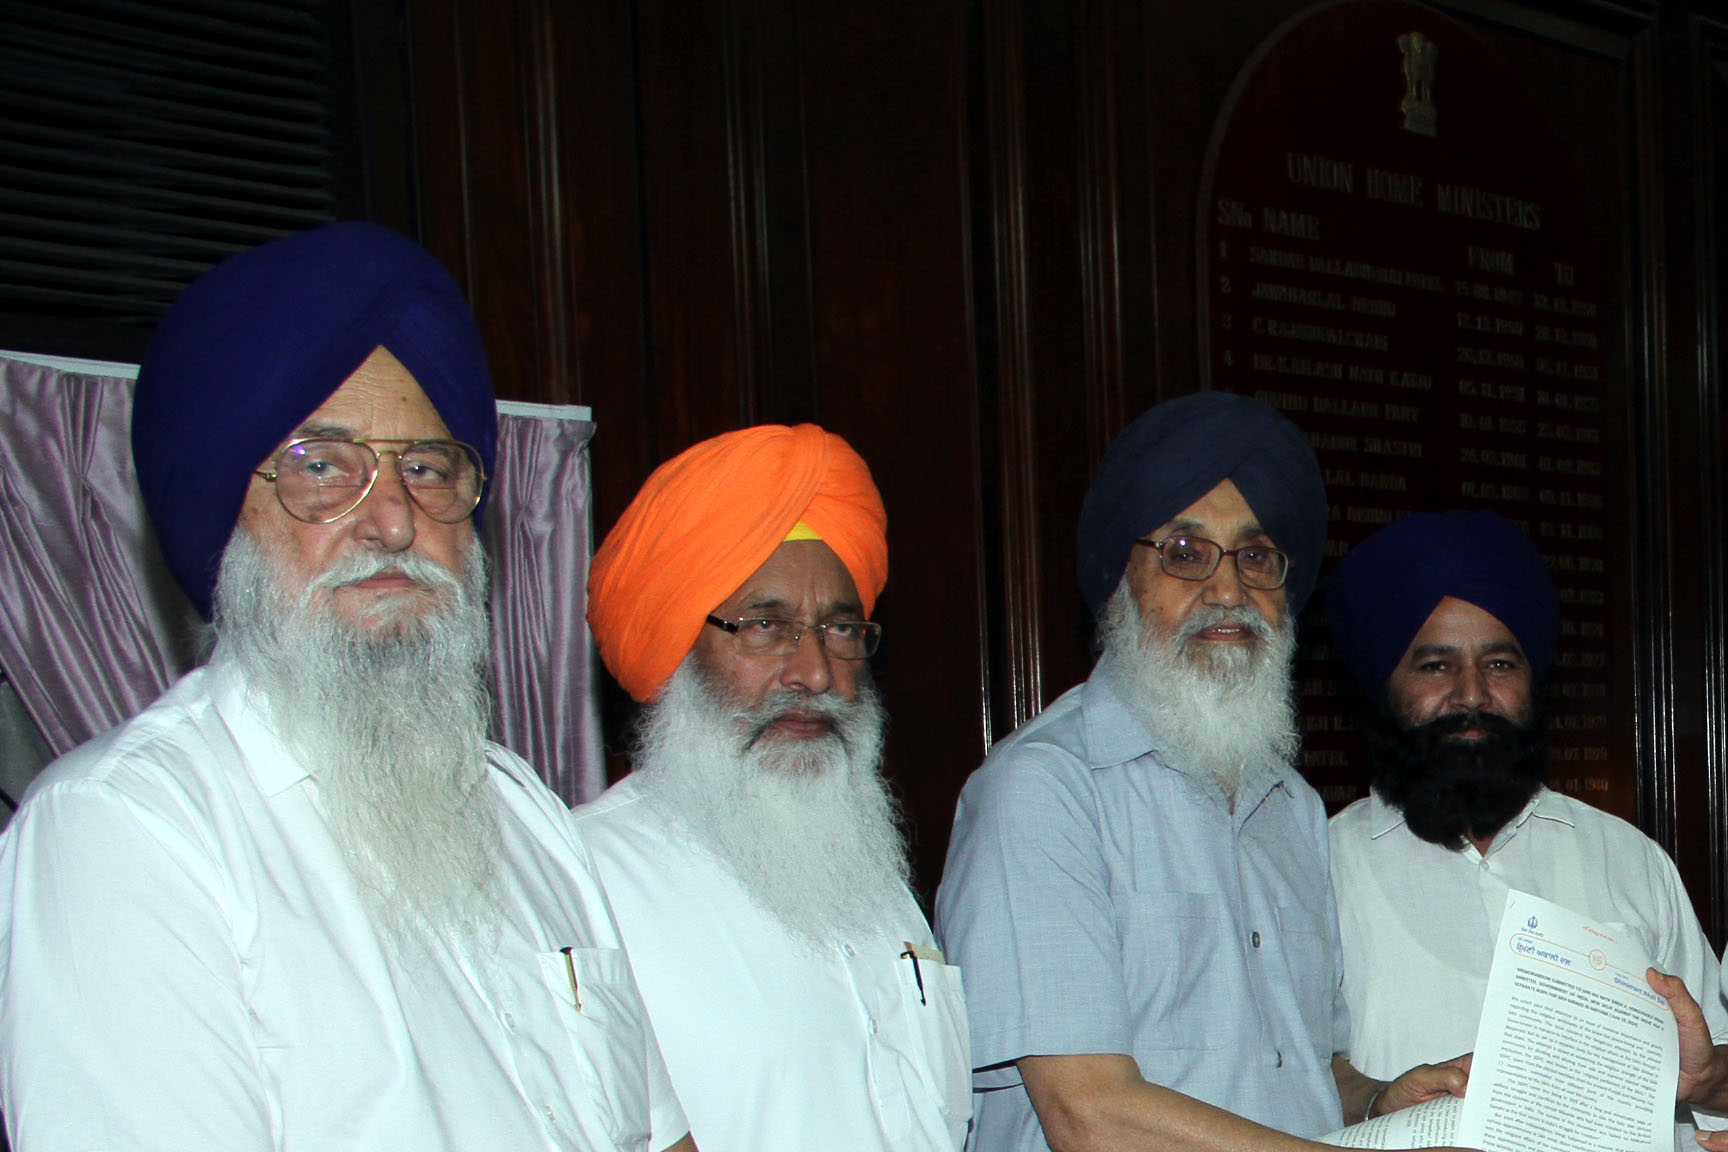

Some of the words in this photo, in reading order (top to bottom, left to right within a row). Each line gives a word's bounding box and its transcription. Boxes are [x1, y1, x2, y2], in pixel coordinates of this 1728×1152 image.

[1286, 152, 1353, 194] UNION
[1366, 165, 1423, 208] HOME
[1437, 183, 1542, 231] MINISTERS
[1263, 206, 1320, 240] NAME
[1218, 240, 1227, 258] 1
[1467, 245, 1515, 278] FROM
[1553, 261, 1574, 287] TO
[1219, 276, 1231, 293] 2
[1221, 313, 1232, 331] 3
[1222, 349, 1234, 367] 4
